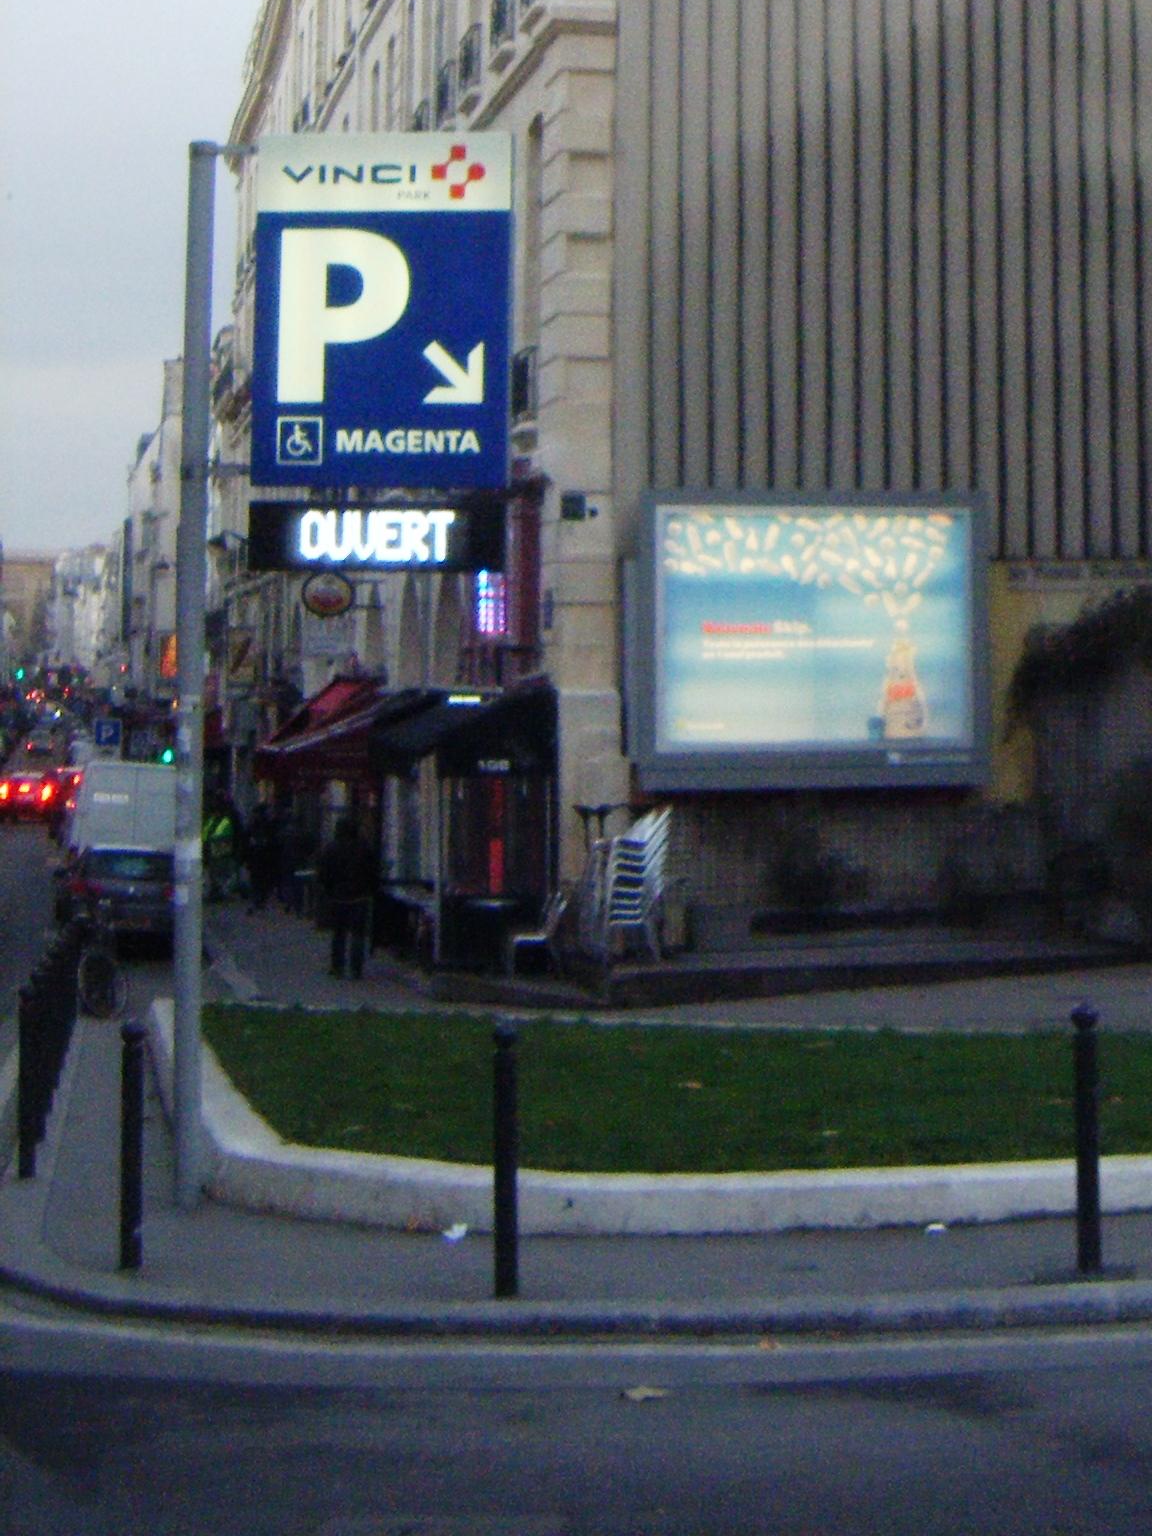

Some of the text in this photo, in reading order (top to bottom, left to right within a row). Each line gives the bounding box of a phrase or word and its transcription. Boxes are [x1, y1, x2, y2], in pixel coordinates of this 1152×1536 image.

[282, 163, 417, 184] VINCI
[397, 190, 432, 200] PARK
[276, 227, 411, 403] P
[335, 429, 481, 453] MAGENTA
[299, 509, 456, 562] OUVERT
